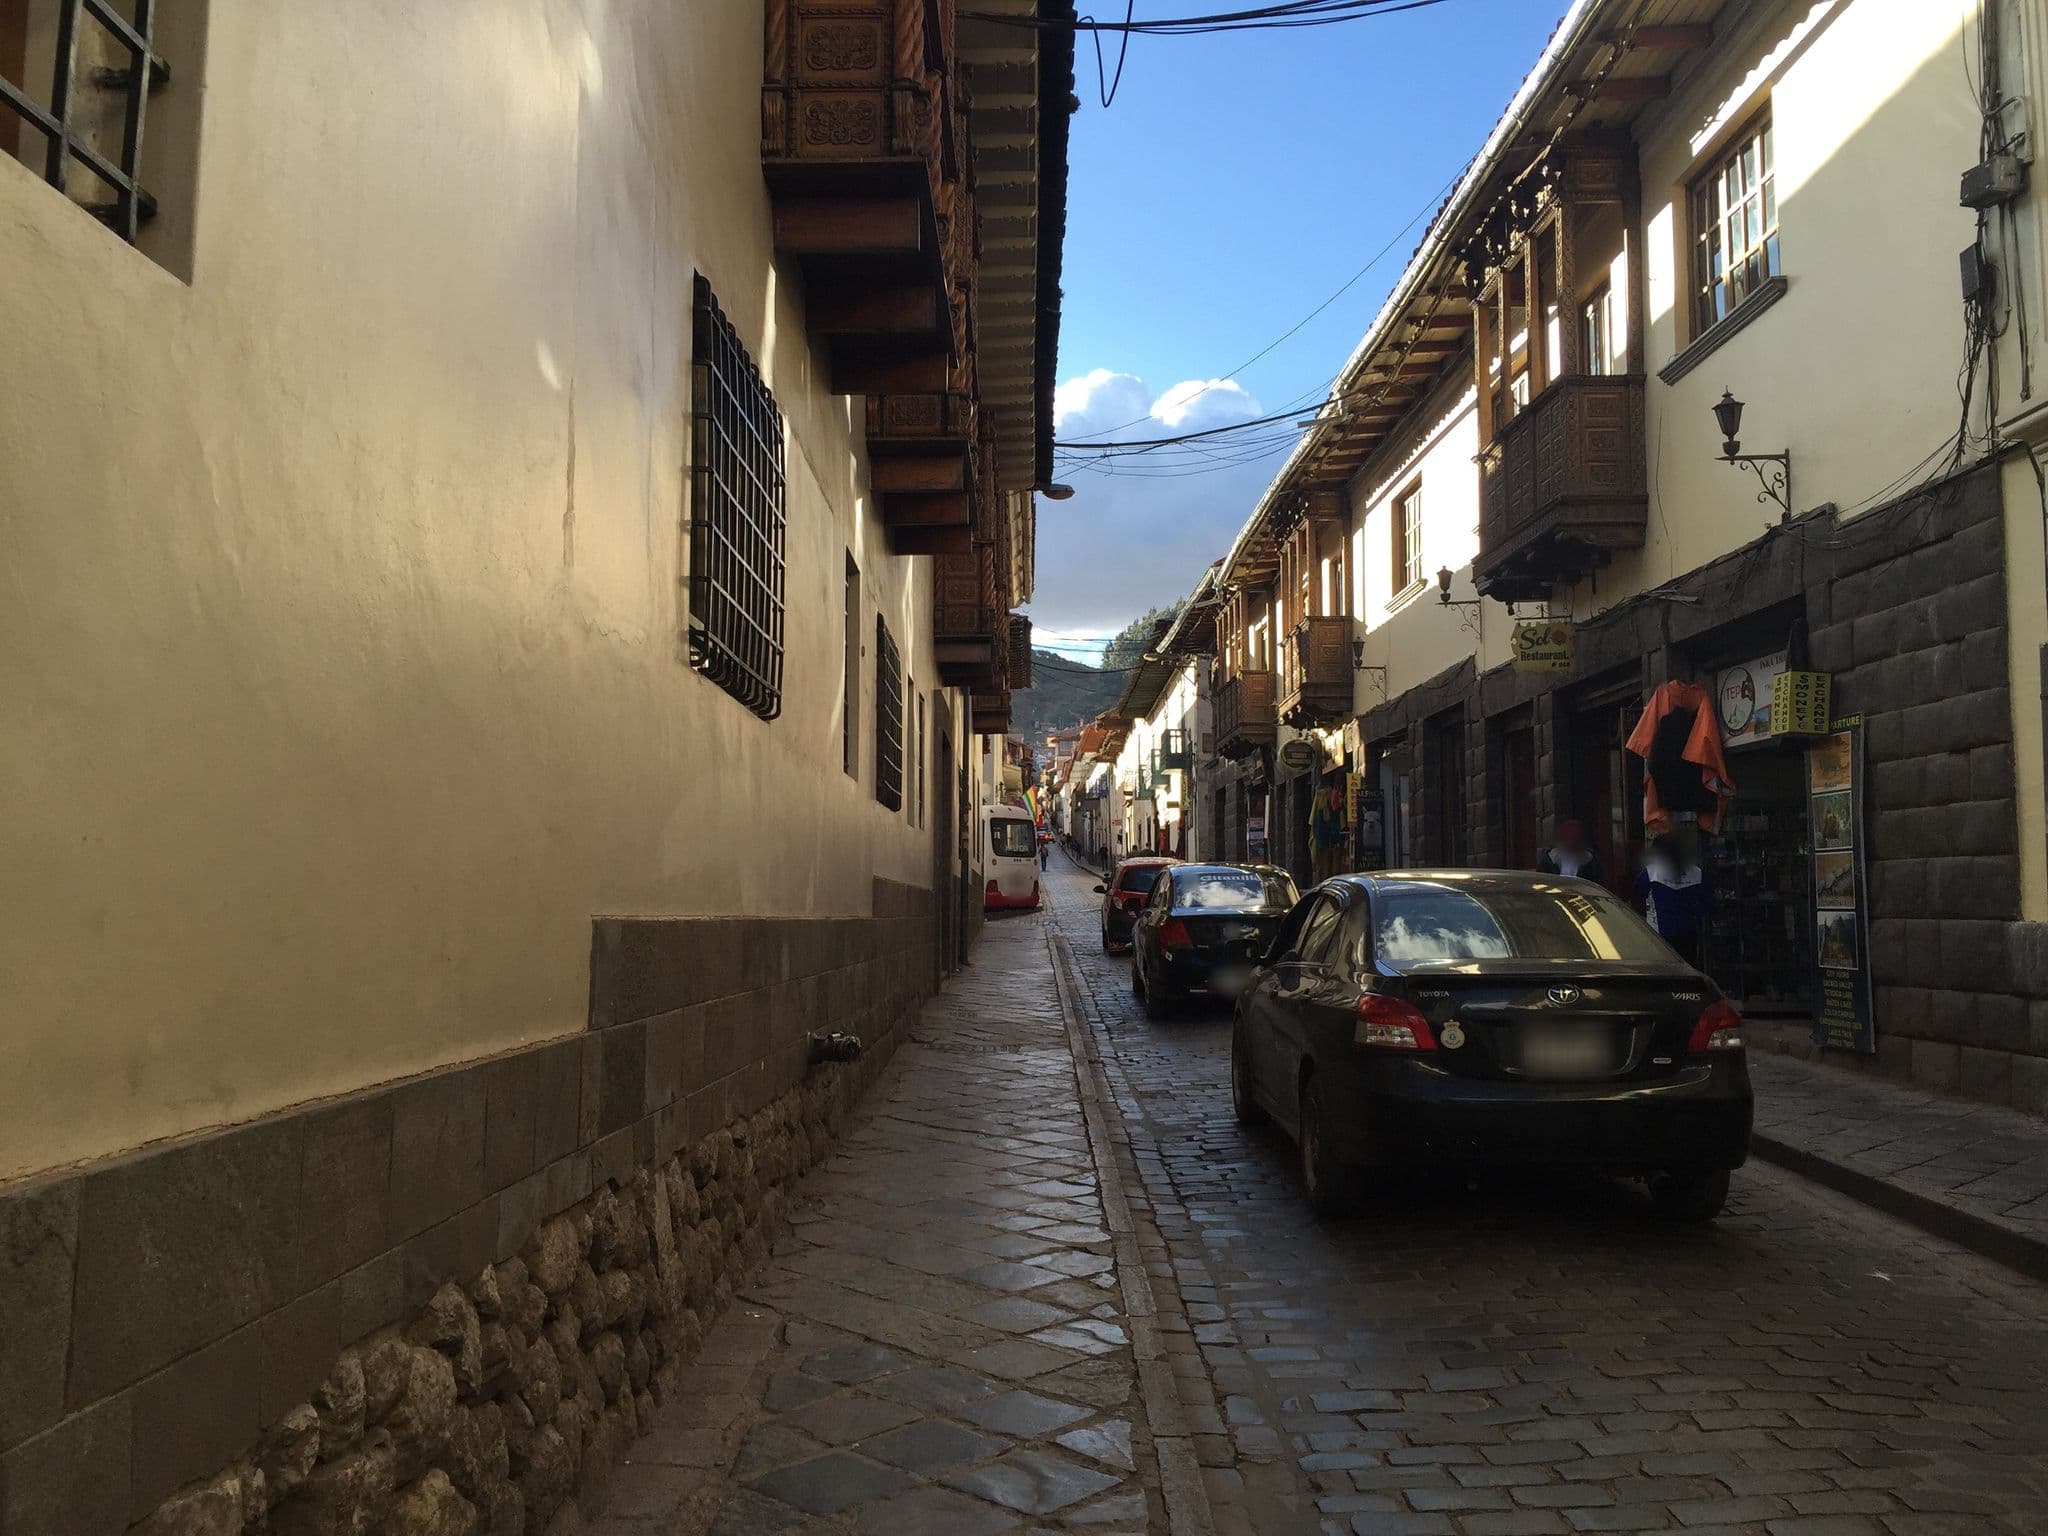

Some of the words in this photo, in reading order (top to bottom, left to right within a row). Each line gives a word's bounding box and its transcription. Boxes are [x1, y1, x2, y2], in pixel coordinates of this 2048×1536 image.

[1519, 626, 1552, 650] Sol
[1814, 676, 1825, 731] EXCHANGE
[1829, 715, 1861, 729] PARTURE
[1671, 992, 1702, 1000] YARIS
